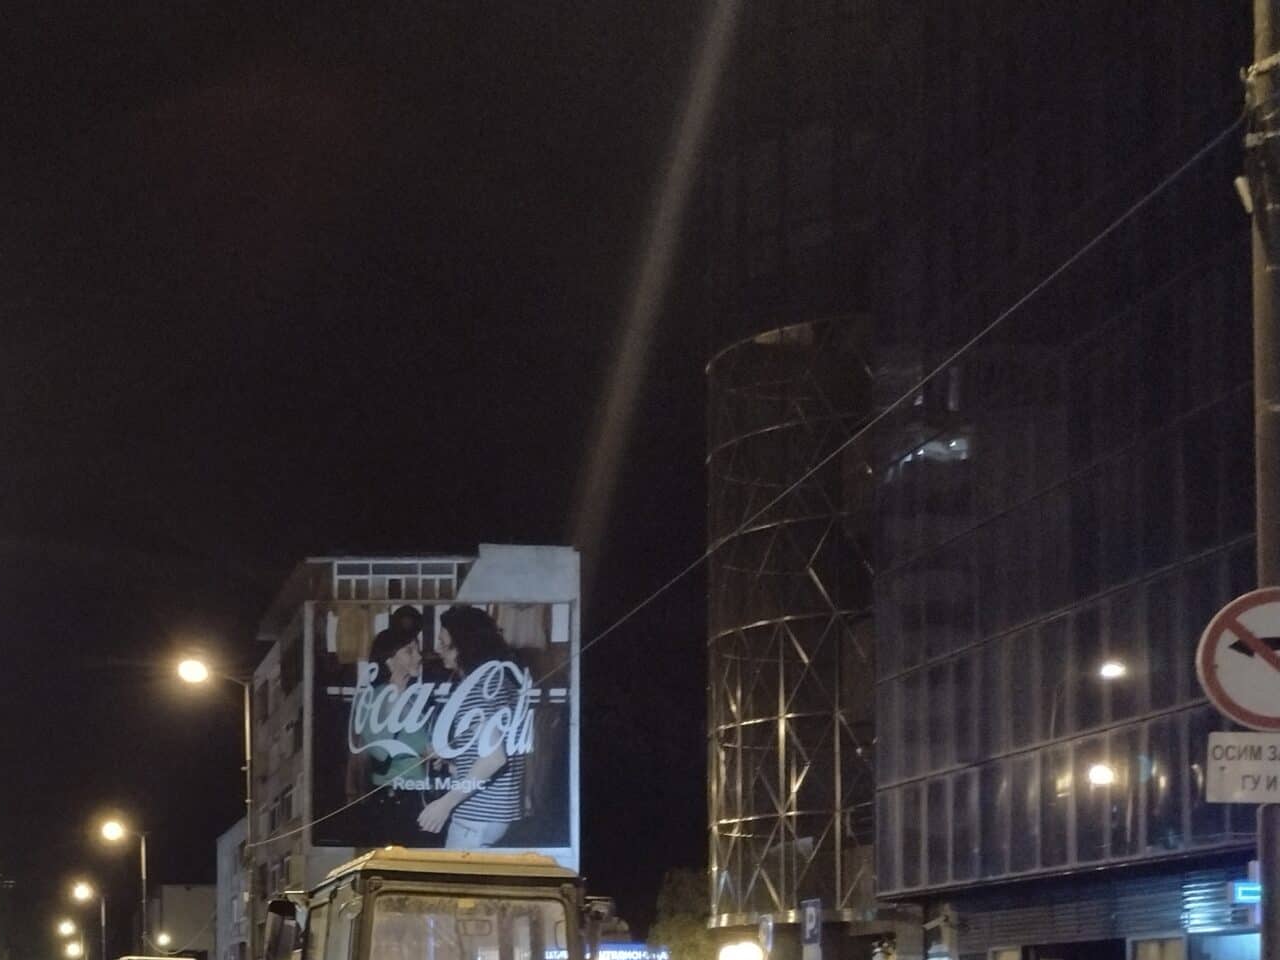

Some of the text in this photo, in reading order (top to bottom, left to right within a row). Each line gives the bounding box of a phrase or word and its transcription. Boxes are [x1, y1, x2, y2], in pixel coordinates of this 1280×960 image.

[1212, 744, 1280, 761] ОСИМ З
[393, 777, 486, 793] Real Magic
[1241, 775, 1261, 791] ГУ
